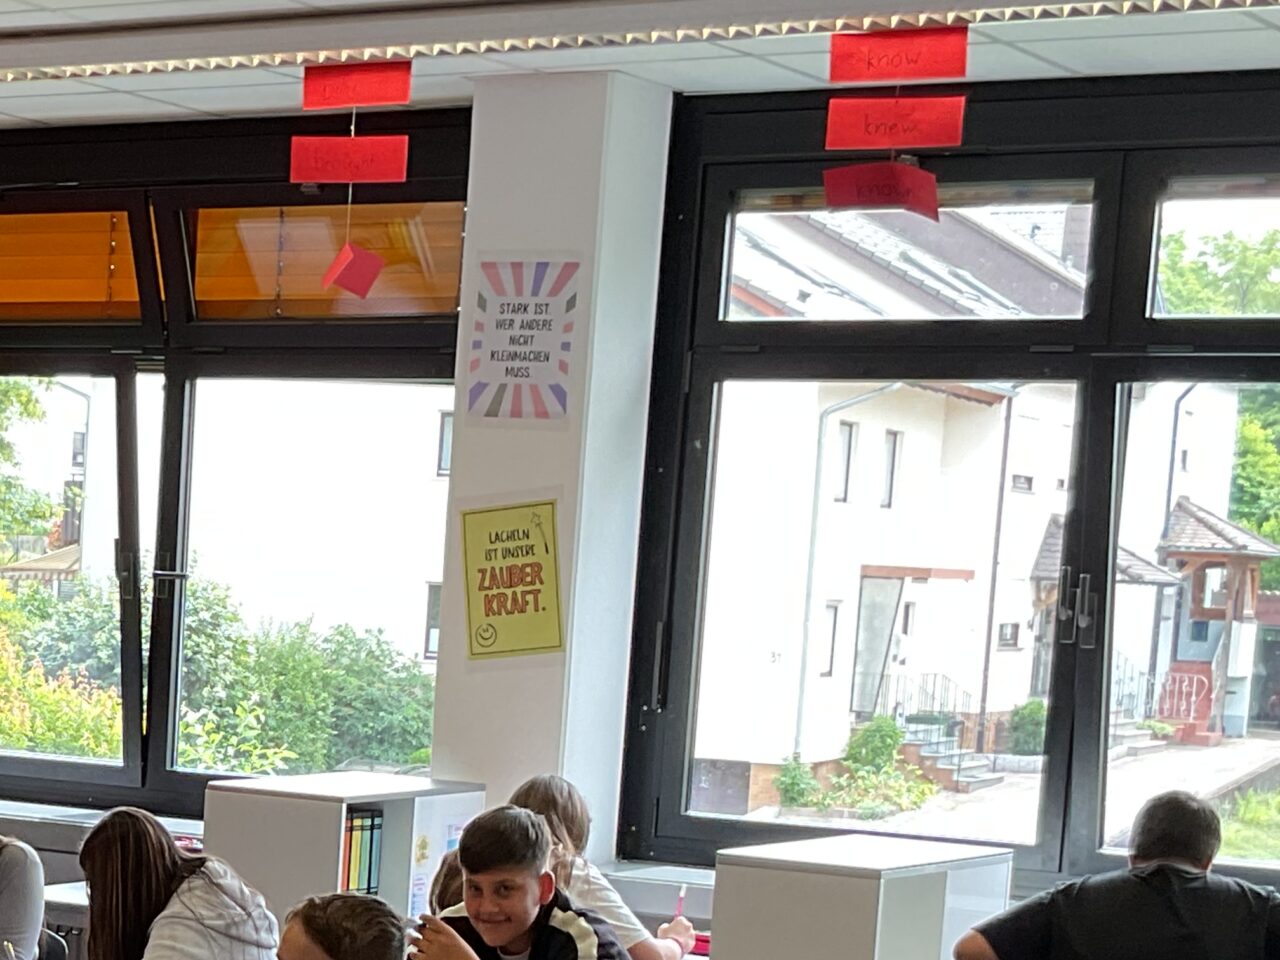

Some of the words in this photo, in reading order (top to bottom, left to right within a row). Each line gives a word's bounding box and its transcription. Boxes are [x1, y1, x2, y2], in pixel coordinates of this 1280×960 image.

[866, 49, 921, 71] know
[863, 112, 918, 136] knew
[499, 303, 529, 315] STARK
[496, 318, 515, 330] WER
[519, 318, 554, 332] ANDERE
[501, 544, 536, 560] UNSERE
[477, 562, 545, 592] ZAUBER
[484, 589, 546, 617] KRAFT.
